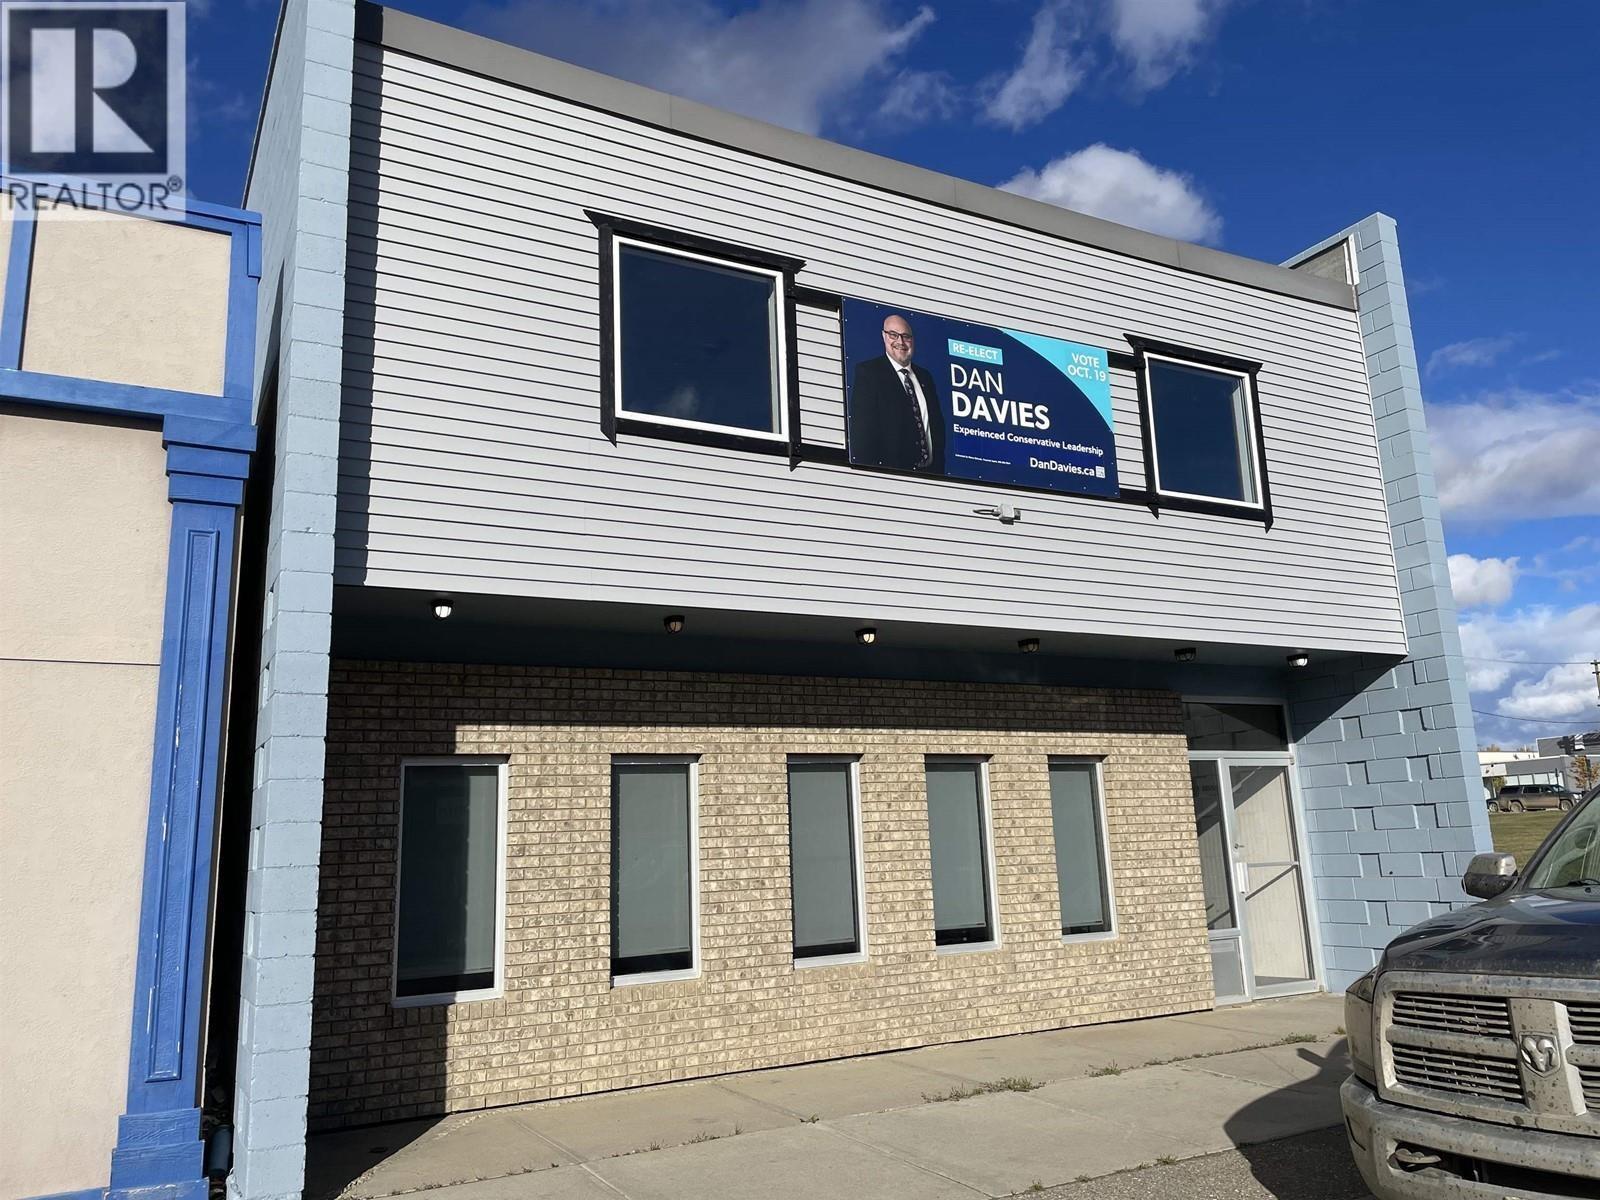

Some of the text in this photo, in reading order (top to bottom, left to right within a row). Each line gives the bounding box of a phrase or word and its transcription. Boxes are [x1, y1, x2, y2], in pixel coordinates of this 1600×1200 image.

[953, 342, 998, 360] RE-ELECT
[1071, 352, 1100, 368] VOTE
[950, 363, 1003, 395] DAN
[1067, 364, 1106, 382] OCT. 19
[952, 390, 1050, 430] DAVIES
[953, 423, 1104, 457] Experienced Conservative Leadership
[1029, 457, 1095, 477] DanDavies.ca
